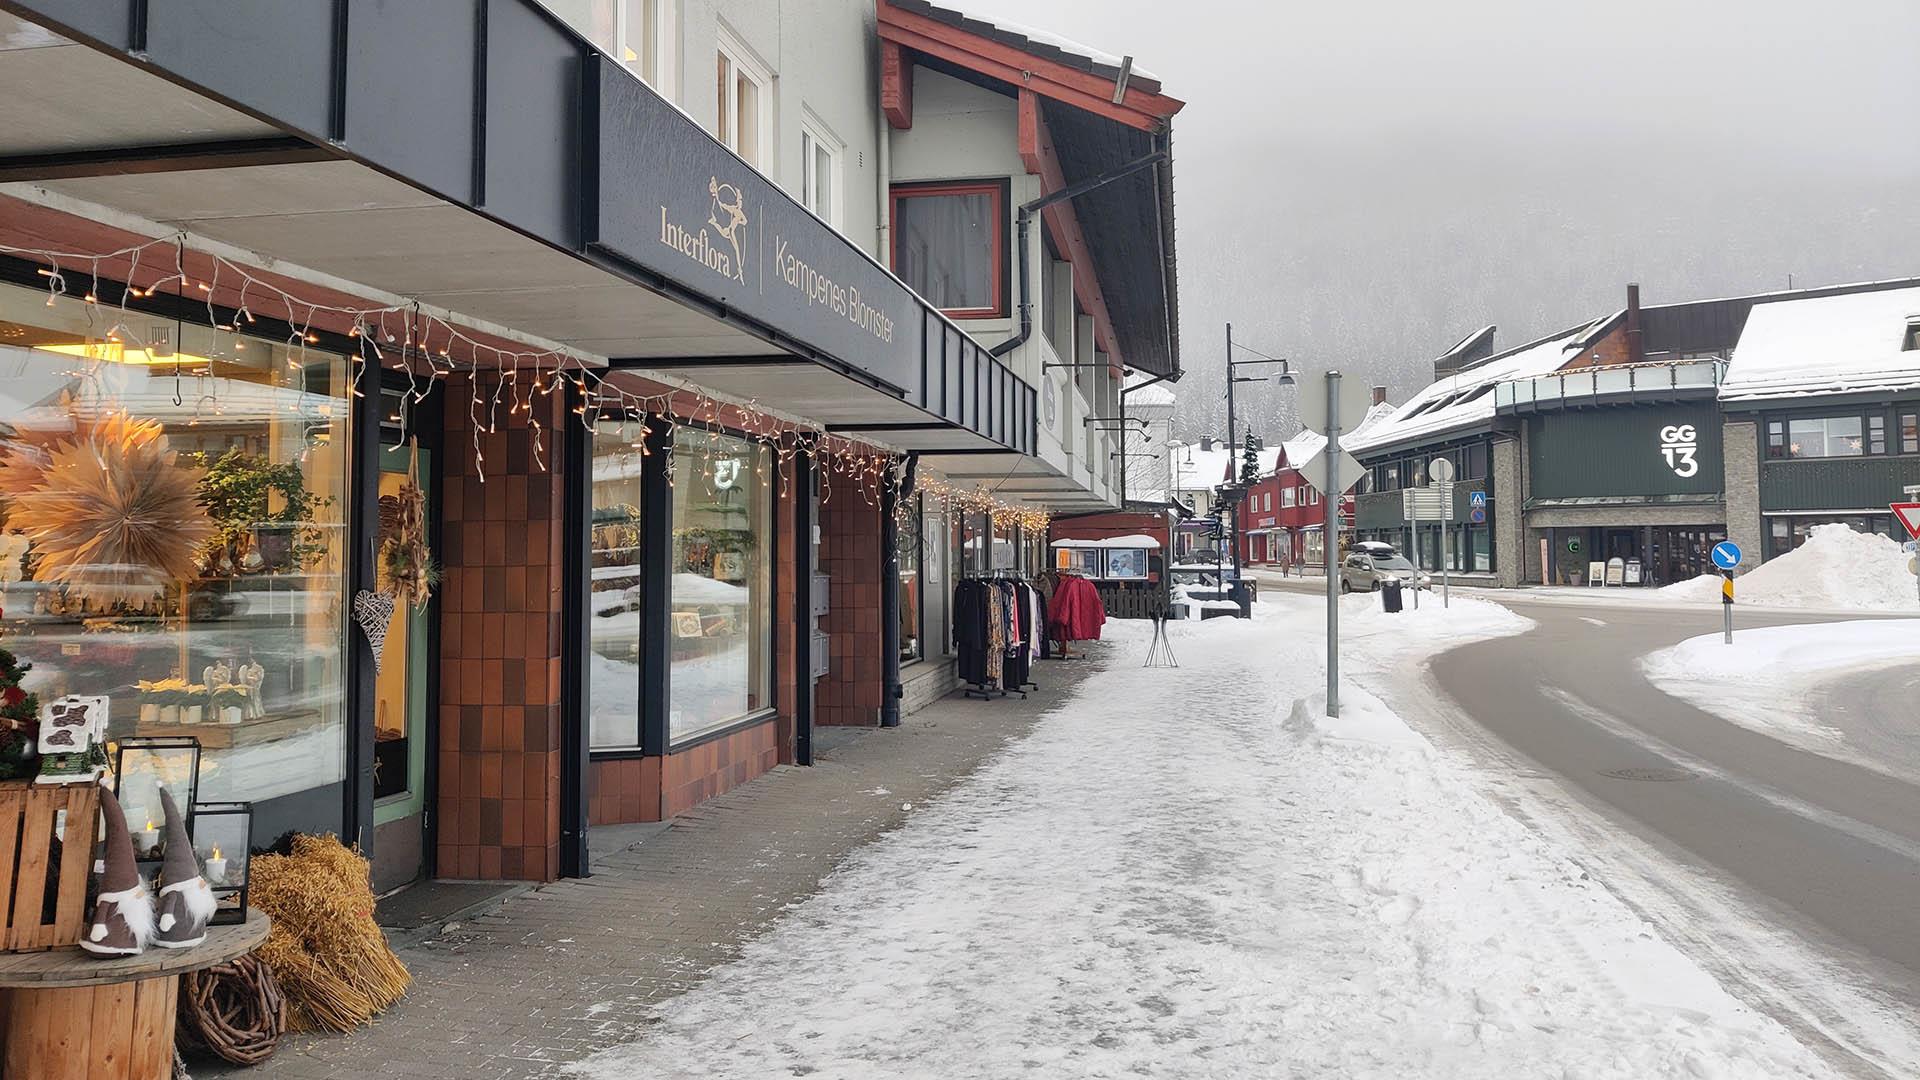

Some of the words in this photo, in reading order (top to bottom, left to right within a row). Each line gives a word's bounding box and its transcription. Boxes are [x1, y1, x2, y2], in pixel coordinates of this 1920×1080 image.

[661, 206, 731, 277] Interflora
[775, 235, 847, 316] Kampenes
[848, 286, 894, 343] Blomster
[1660, 424, 1697, 443] GG
[1661, 447, 1699, 478] 13
